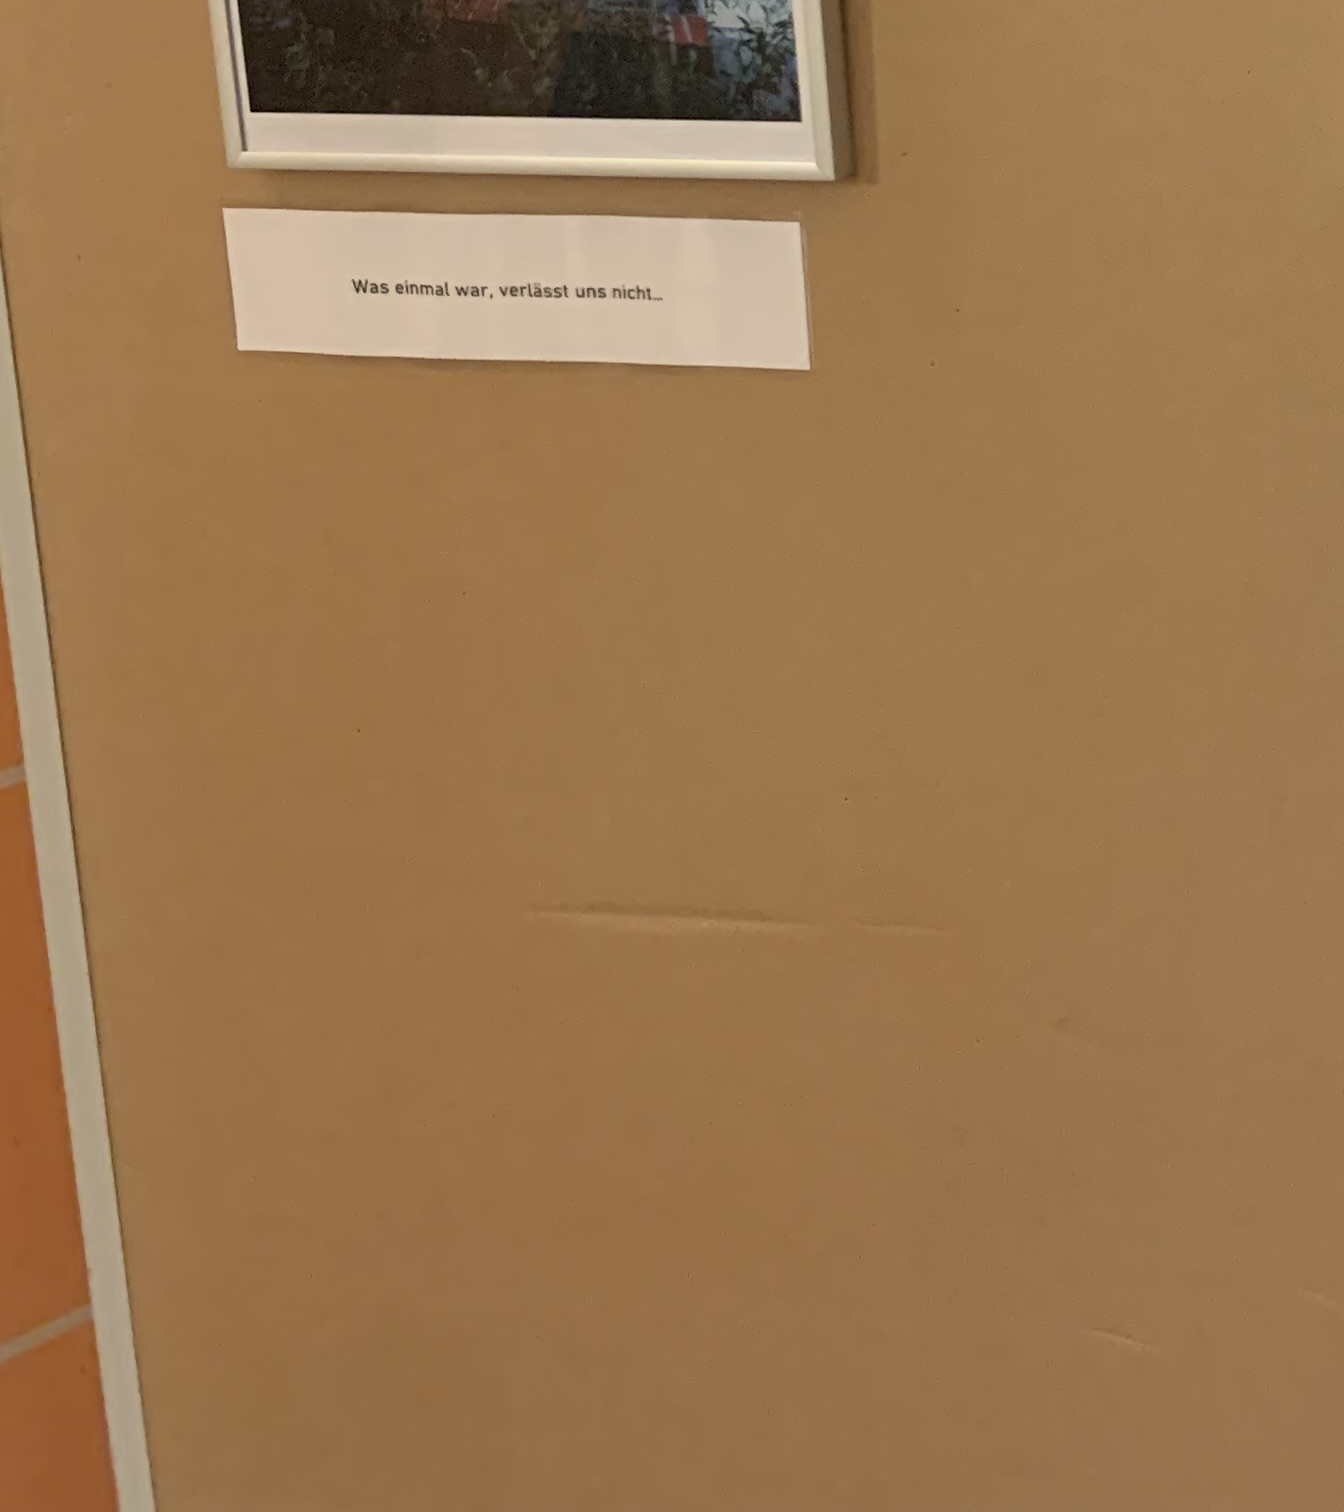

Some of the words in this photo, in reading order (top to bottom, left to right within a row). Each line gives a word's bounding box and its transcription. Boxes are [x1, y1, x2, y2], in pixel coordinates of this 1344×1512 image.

[351, 278, 390, 295] Was
[395, 279, 450, 297] einmal
[454, 285, 494, 300] war,
[498, 282, 569, 299] verlässt
[575, 287, 607, 299] uns
